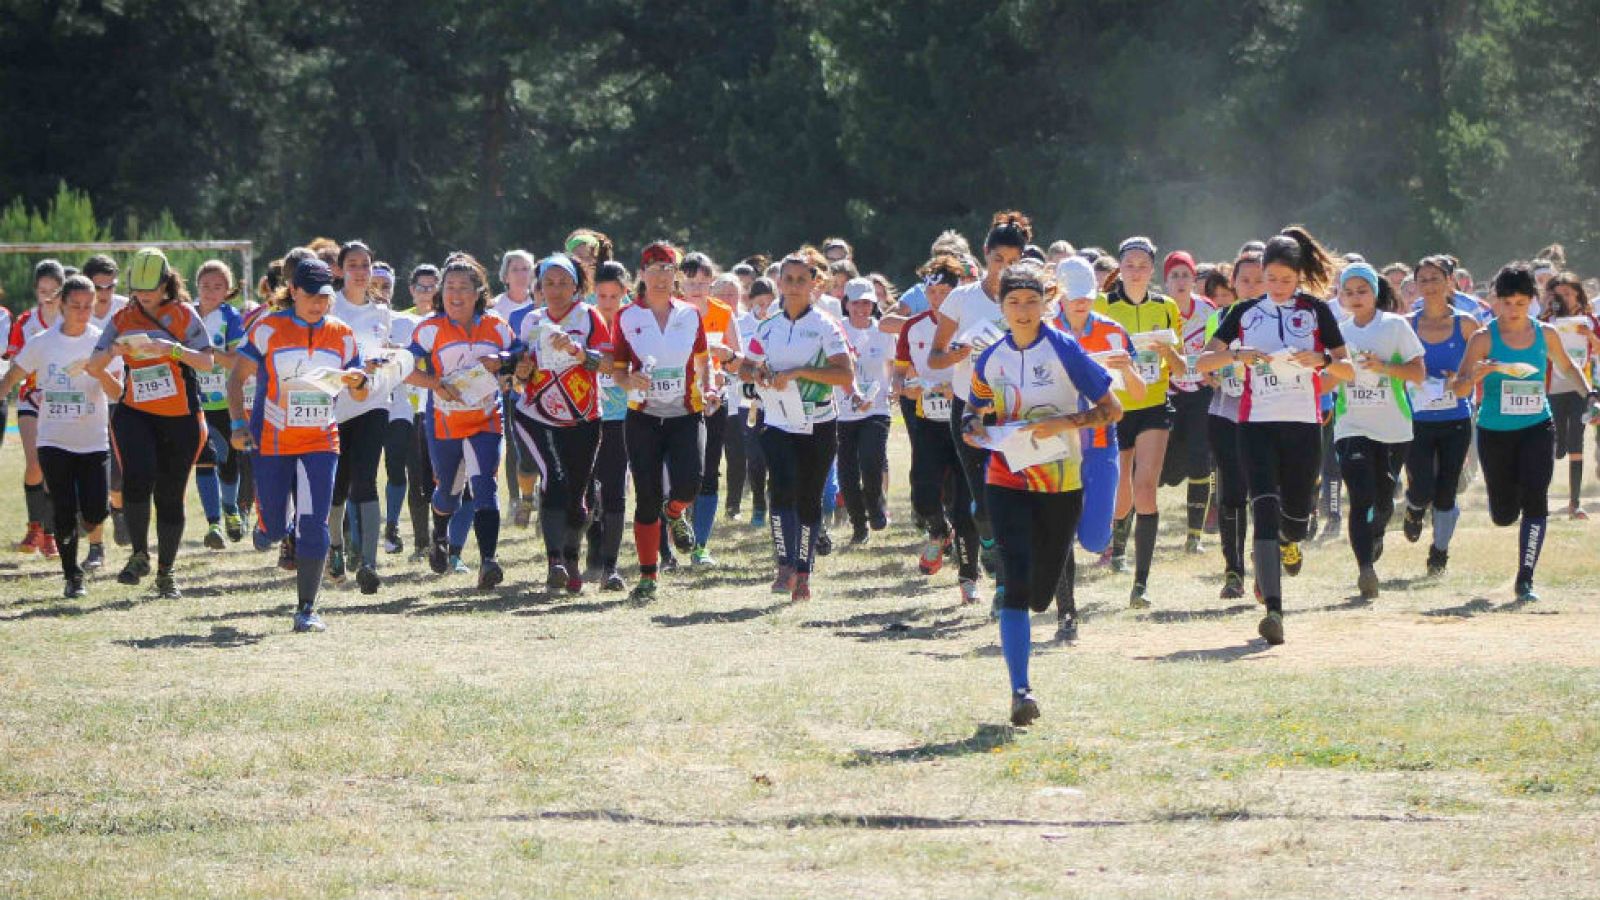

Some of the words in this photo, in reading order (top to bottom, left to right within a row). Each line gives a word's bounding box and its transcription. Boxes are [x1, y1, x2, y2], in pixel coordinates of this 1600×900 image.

[138, 378, 171, 394] 219-1
[1351, 388, 1386, 400] 102-1
[1510, 395, 1541, 406] 101-1
[49, 404, 81, 415] 221-1
[294, 405, 329, 418] 211-1
